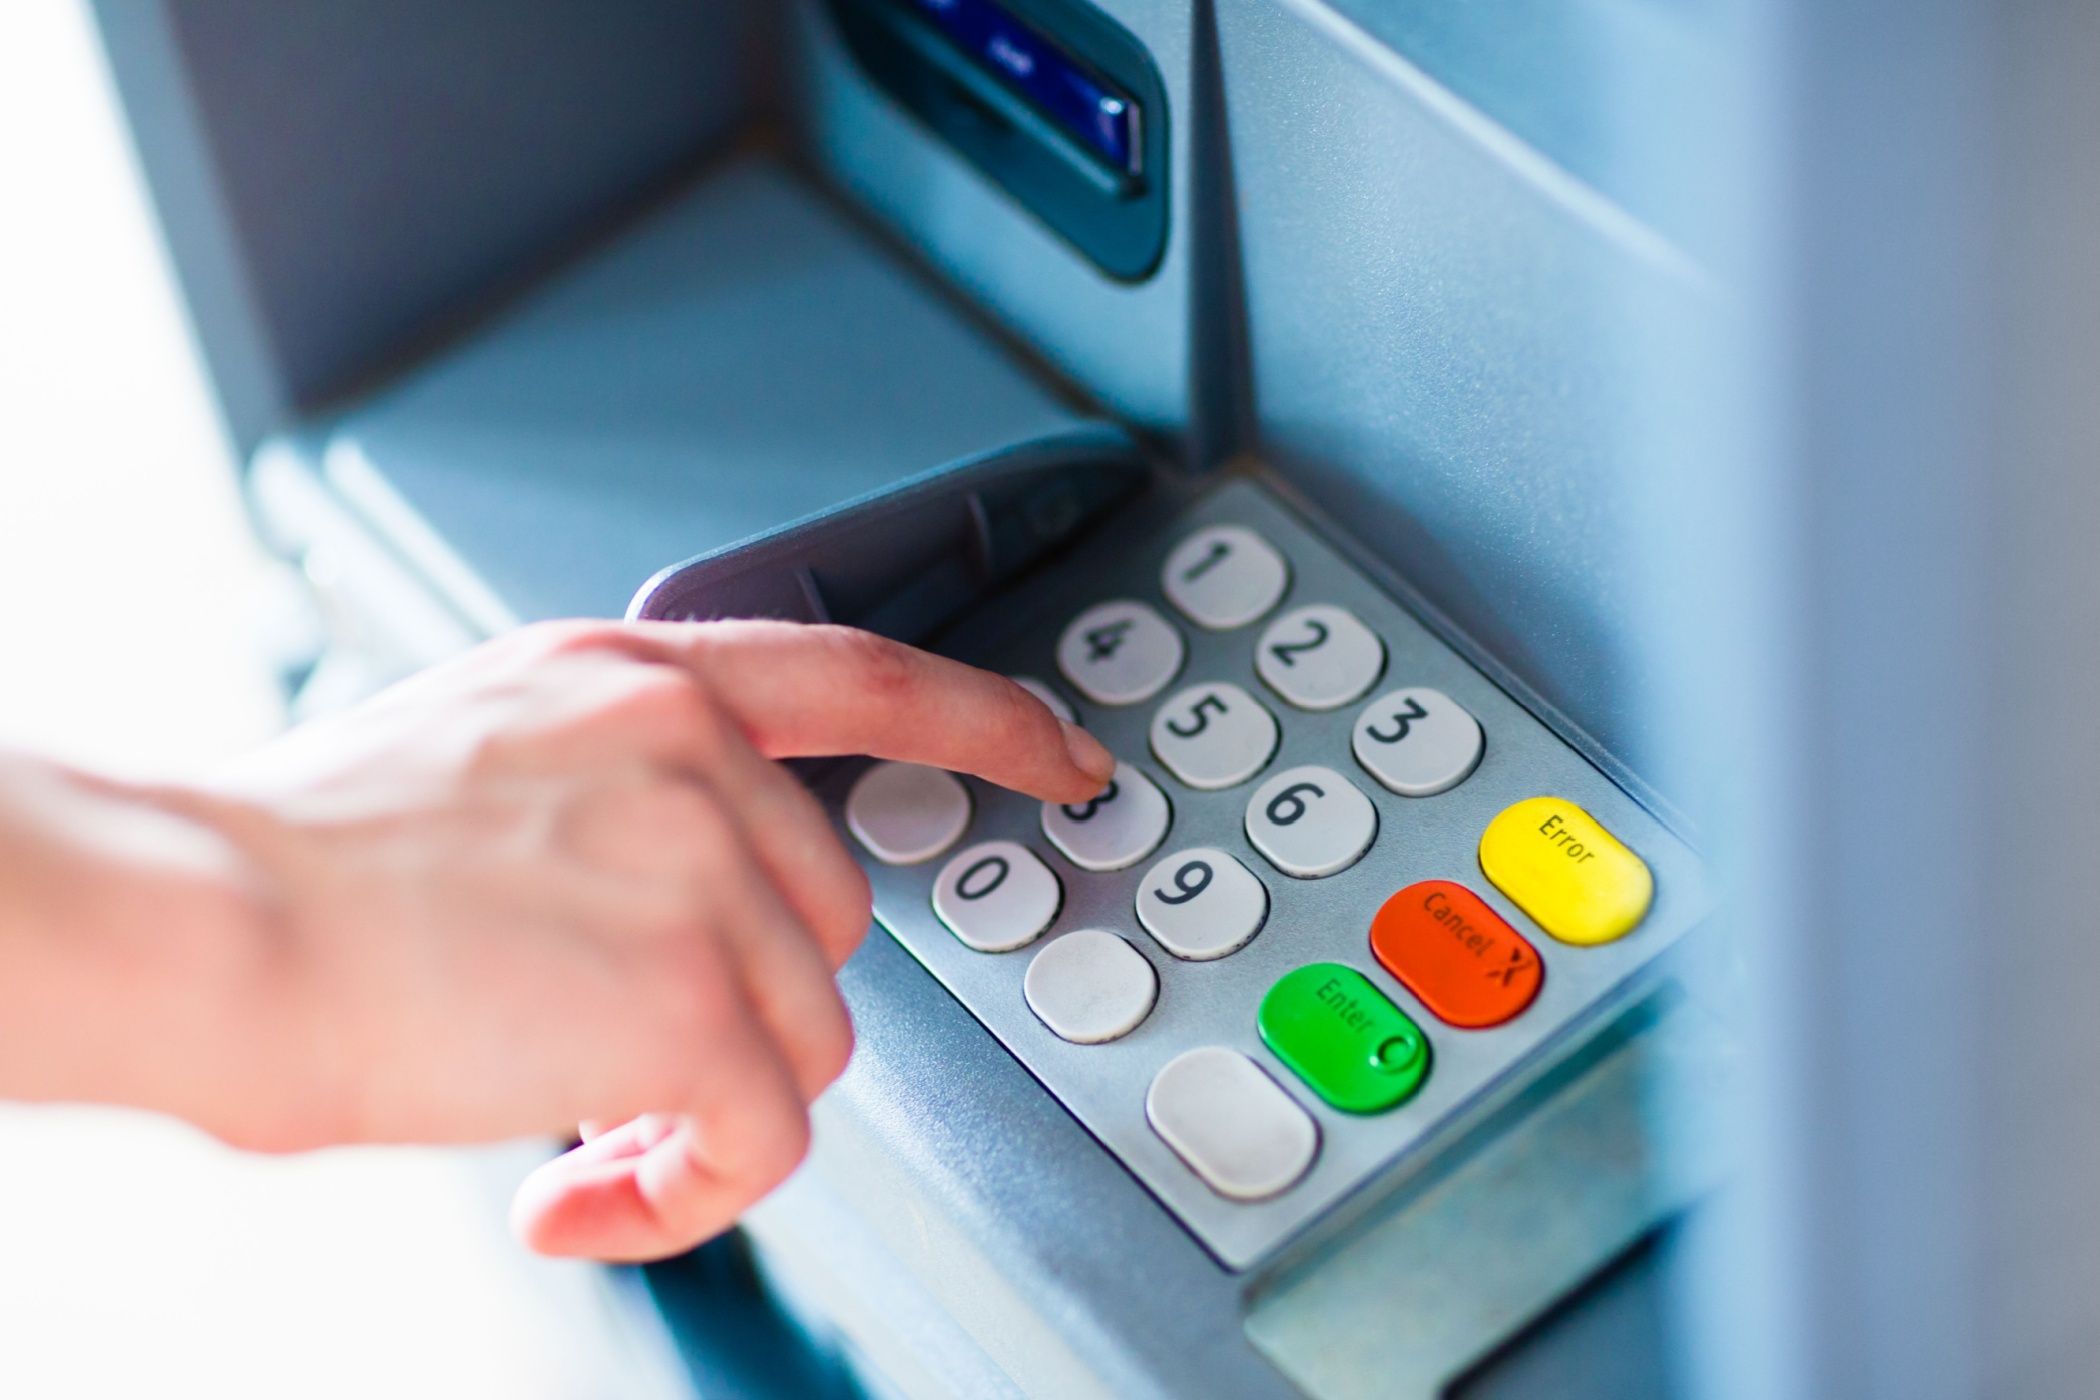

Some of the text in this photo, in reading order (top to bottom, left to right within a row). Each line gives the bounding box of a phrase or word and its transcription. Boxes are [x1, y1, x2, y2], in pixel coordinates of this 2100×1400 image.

[1184, 541, 1231, 583] 1
[1083, 618, 1135, 660] 4
[1270, 619, 1330, 666] 2
[1166, 694, 1228, 739] 5
[1366, 697, 1429, 743] 3
[1266, 783, 1325, 825] 6
[1538, 814, 1595, 864] Error
[956, 856, 1010, 900] 0
[1154, 860, 1212, 904] 9
[1424, 892, 1493, 956] Cancel
[1317, 979, 1373, 1032] Enter
